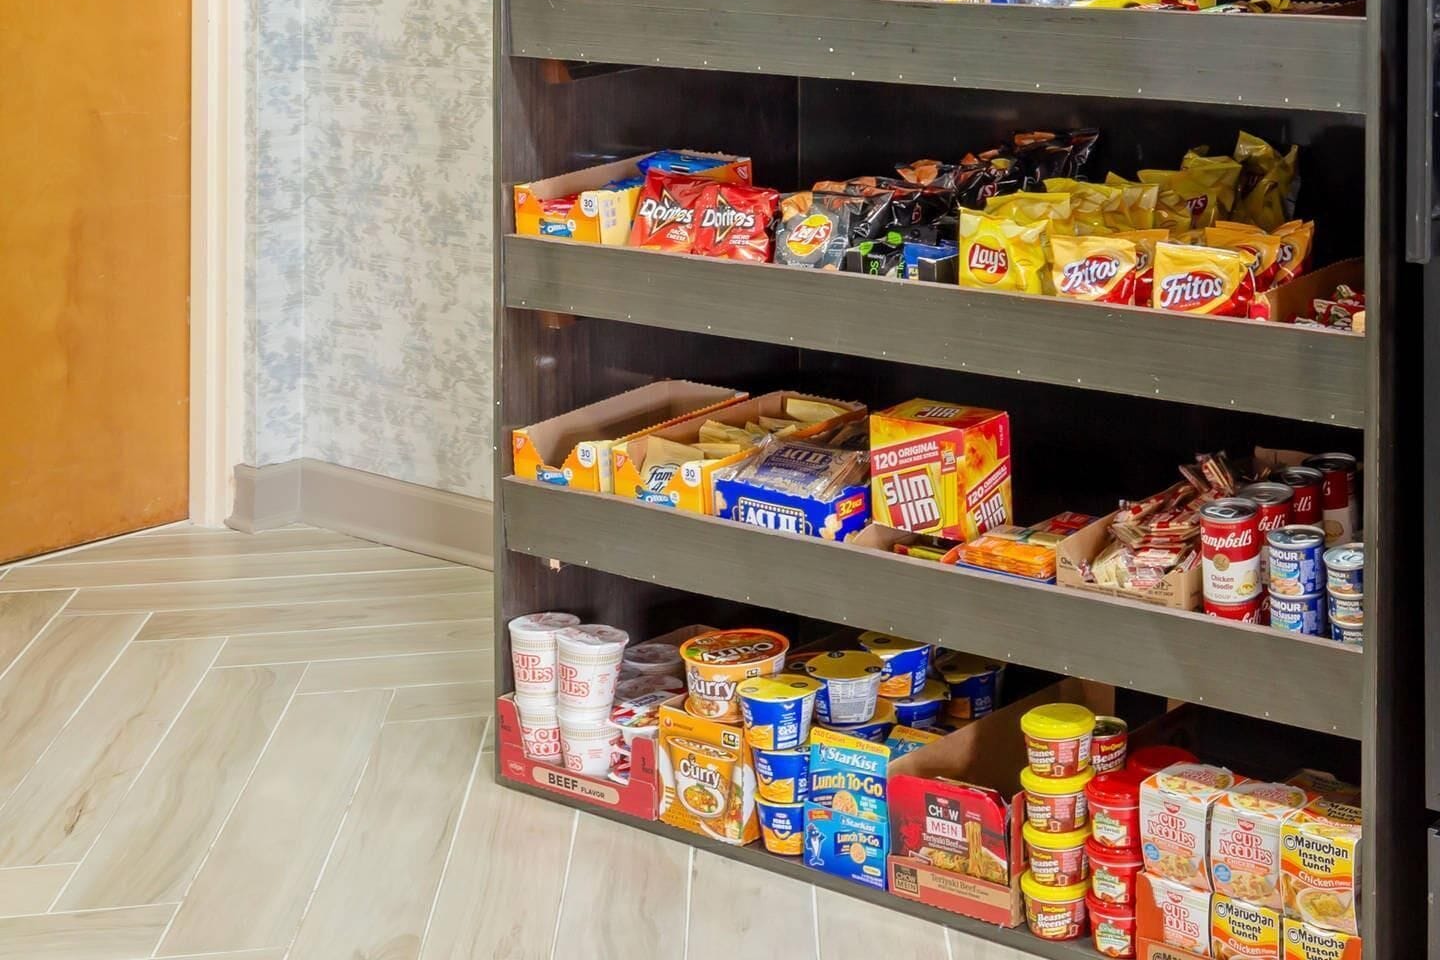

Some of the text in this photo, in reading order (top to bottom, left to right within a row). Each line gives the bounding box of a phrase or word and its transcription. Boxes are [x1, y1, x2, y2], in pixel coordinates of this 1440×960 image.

[639, 197, 695, 224] Doritos
[701, 206, 755, 228] Doritos
[970, 244, 1008, 276] Lay's
[1061, 255, 1120, 292] Fritos
[1160, 272, 1224, 308] Fritos
[580, 448, 591, 458] 30
[873, 441, 938, 470] 120 ORIGINAL
[685, 468, 696, 479] 30
[967, 486, 984, 507] 120
[838, 500, 854, 516] 32
[746, 503, 798, 534] ACT II
[1210, 573, 1235, 583] Chicken
[1211, 582, 1234, 590] Noodle
[515, 666, 553, 683] DLES
[687, 670, 737, 701] Curry
[534, 726, 560, 742] CU
[826, 747, 878, 772] StarKist
[680, 758, 721, 789] Curry
[548, 772, 605, 799] BEEF FLAVOR
[812, 772, 883, 796] Lunch To-Go
[845, 818, 876, 832] StarKist
[931, 821, 958, 837] MEIN
[1158, 813, 1186, 830] CUP
[837, 832, 858, 843] Lunch
[922, 833, 946, 846] Teriyaki
[946, 838, 959, 848] Beef
[1147, 820, 1196, 849] NOODLES
[1232, 830, 1262, 848] CUP
[1220, 839, 1273, 865] NOODLES
[1294, 835, 1348, 859] Maruchan
[1298, 849, 1335, 867] Instant
[1302, 859, 1332, 874] Lunch
[896, 872, 917, 883] CHOW
[897, 880, 917, 891] MEIN
[931, 873, 976, 891] Teriyaki Beef
[1298, 870, 1334, 888] Chicken
[1163, 901, 1190, 920] CUP
[1225, 902, 1274, 928] Maruchan
[1228, 917, 1262, 935] Instant
[1231, 927, 1258, 941] Lunch
[1228, 938, 1261, 954] Chicken
[1297, 928, 1345, 949] Marucha
[1301, 941, 1339, 958] Instant
